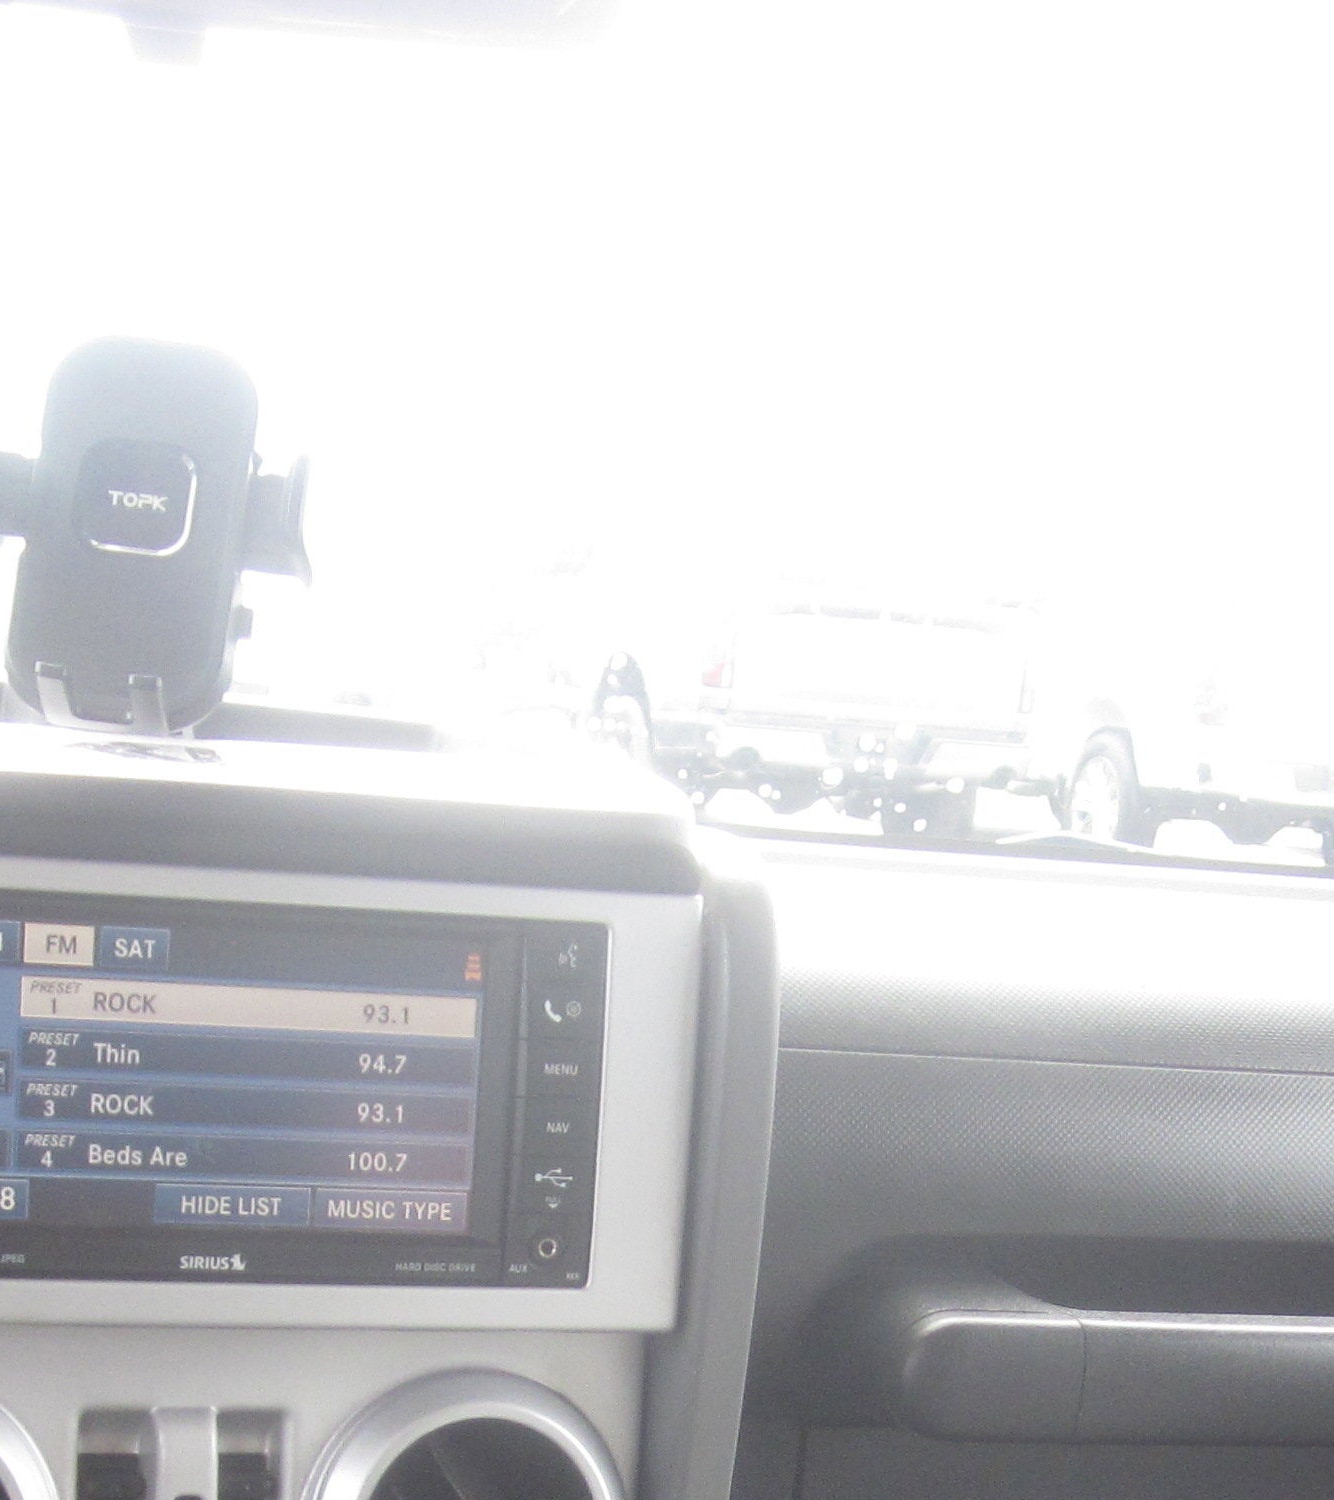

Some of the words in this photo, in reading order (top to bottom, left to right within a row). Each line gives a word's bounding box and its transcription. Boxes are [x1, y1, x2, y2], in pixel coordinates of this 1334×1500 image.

[108, 489, 168, 512] TOPK
[46, 935, 78, 955] FM
[114, 938, 156, 959] SAT
[29, 980, 82, 994] PRESET
[49, 998, 57, 1014] 1
[93, 992, 157, 1014] ROCK
[363, 1004, 409, 1024] 93.1
[28, 1032, 79, 1046] PRESET
[45, 1050, 57, 1066] 2
[94, 1042, 140, 1064] Thin
[359, 1053, 407, 1074] 94.7
[544, 1063, 579, 1075] MENU
[26, 1083, 78, 1097] PRESET
[43, 1100, 55, 1117] 3
[90, 1093, 153, 1116] ROCK
[357, 1103, 403, 1124] 93.1
[546, 1122, 570, 1134] NAV
[24, 1133, 76, 1147] PRESET
[40, 1151, 53, 1167] 4
[88, 1144, 142, 1165] Beds
[149, 1146, 188, 1167] Are
[348, 1152, 407, 1172] 100.7
[181, 1195, 231, 1215] HIDE
[238, 1197, 281, 1216] LIST
[327, 1199, 395, 1220] MUSIC
[403, 1202, 452, 1221] TYPE
[179, 1255, 229, 1271] SIRIUS
[508, 1264, 528, 1273] AUX
